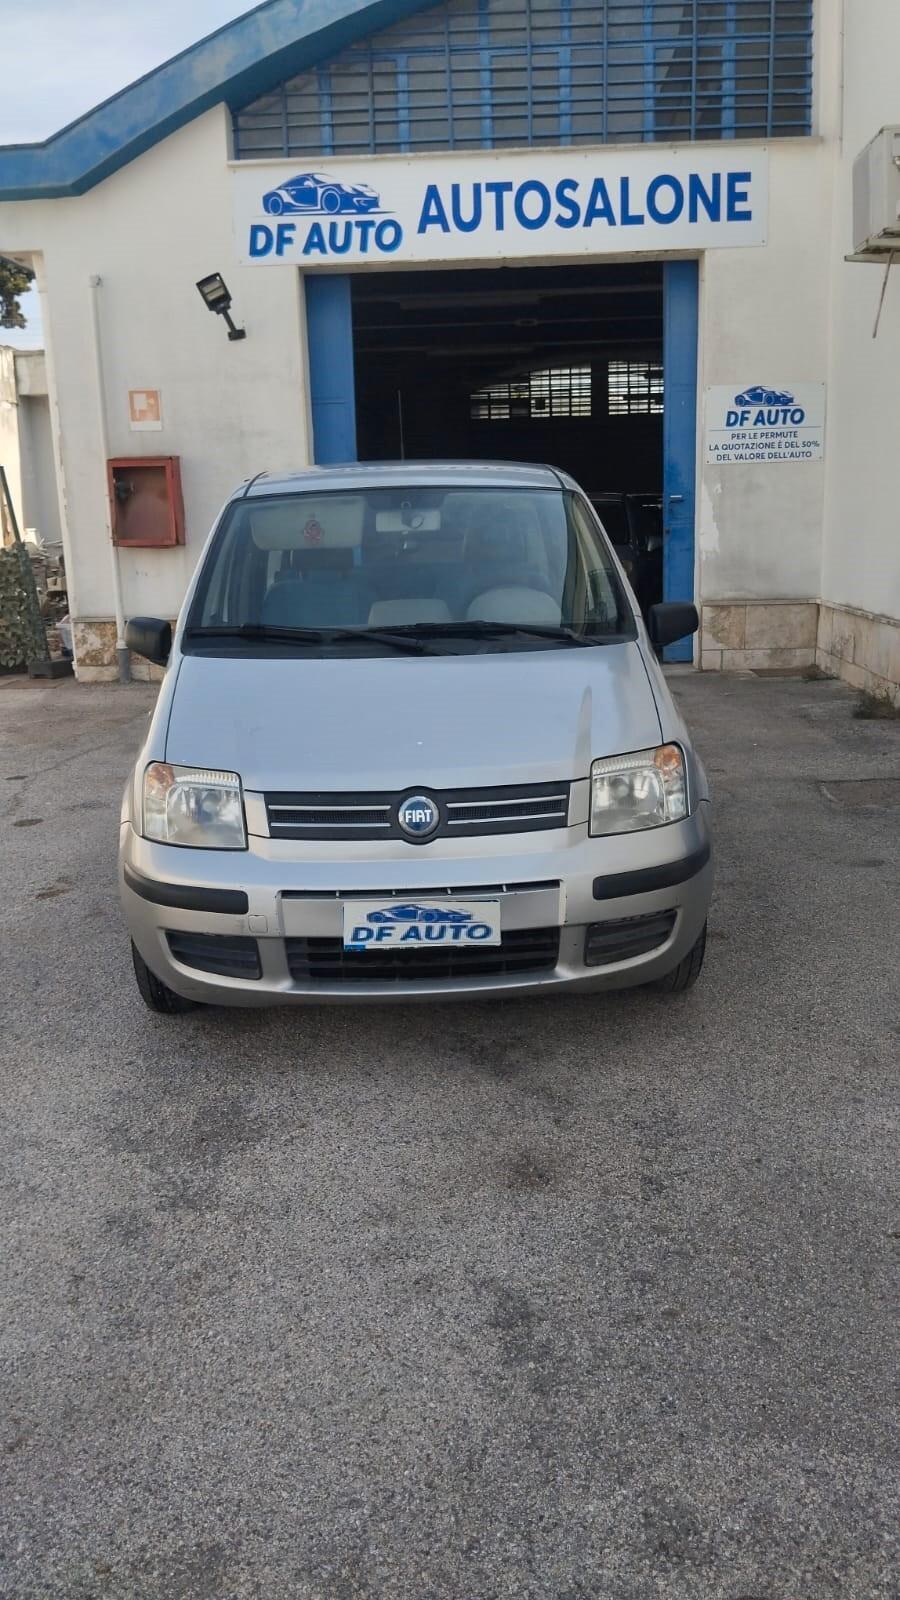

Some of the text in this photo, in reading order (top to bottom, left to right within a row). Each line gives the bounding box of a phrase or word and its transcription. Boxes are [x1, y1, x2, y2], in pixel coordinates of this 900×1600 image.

[417, 171, 752, 234] AUTOSALONE
[249, 219, 402, 257] DF AUTO
[726, 408, 804, 427] DF AUTO
[760, 431, 798, 439] PERMUTE
[722, 442, 775, 451] QUOTAZIONE
[734, 452, 766, 460] VALORE
[768, 451, 812, 460] DELL'AUTO
[406, 810, 432, 822] FIAT
[352, 924, 492, 942] DF AUTO
